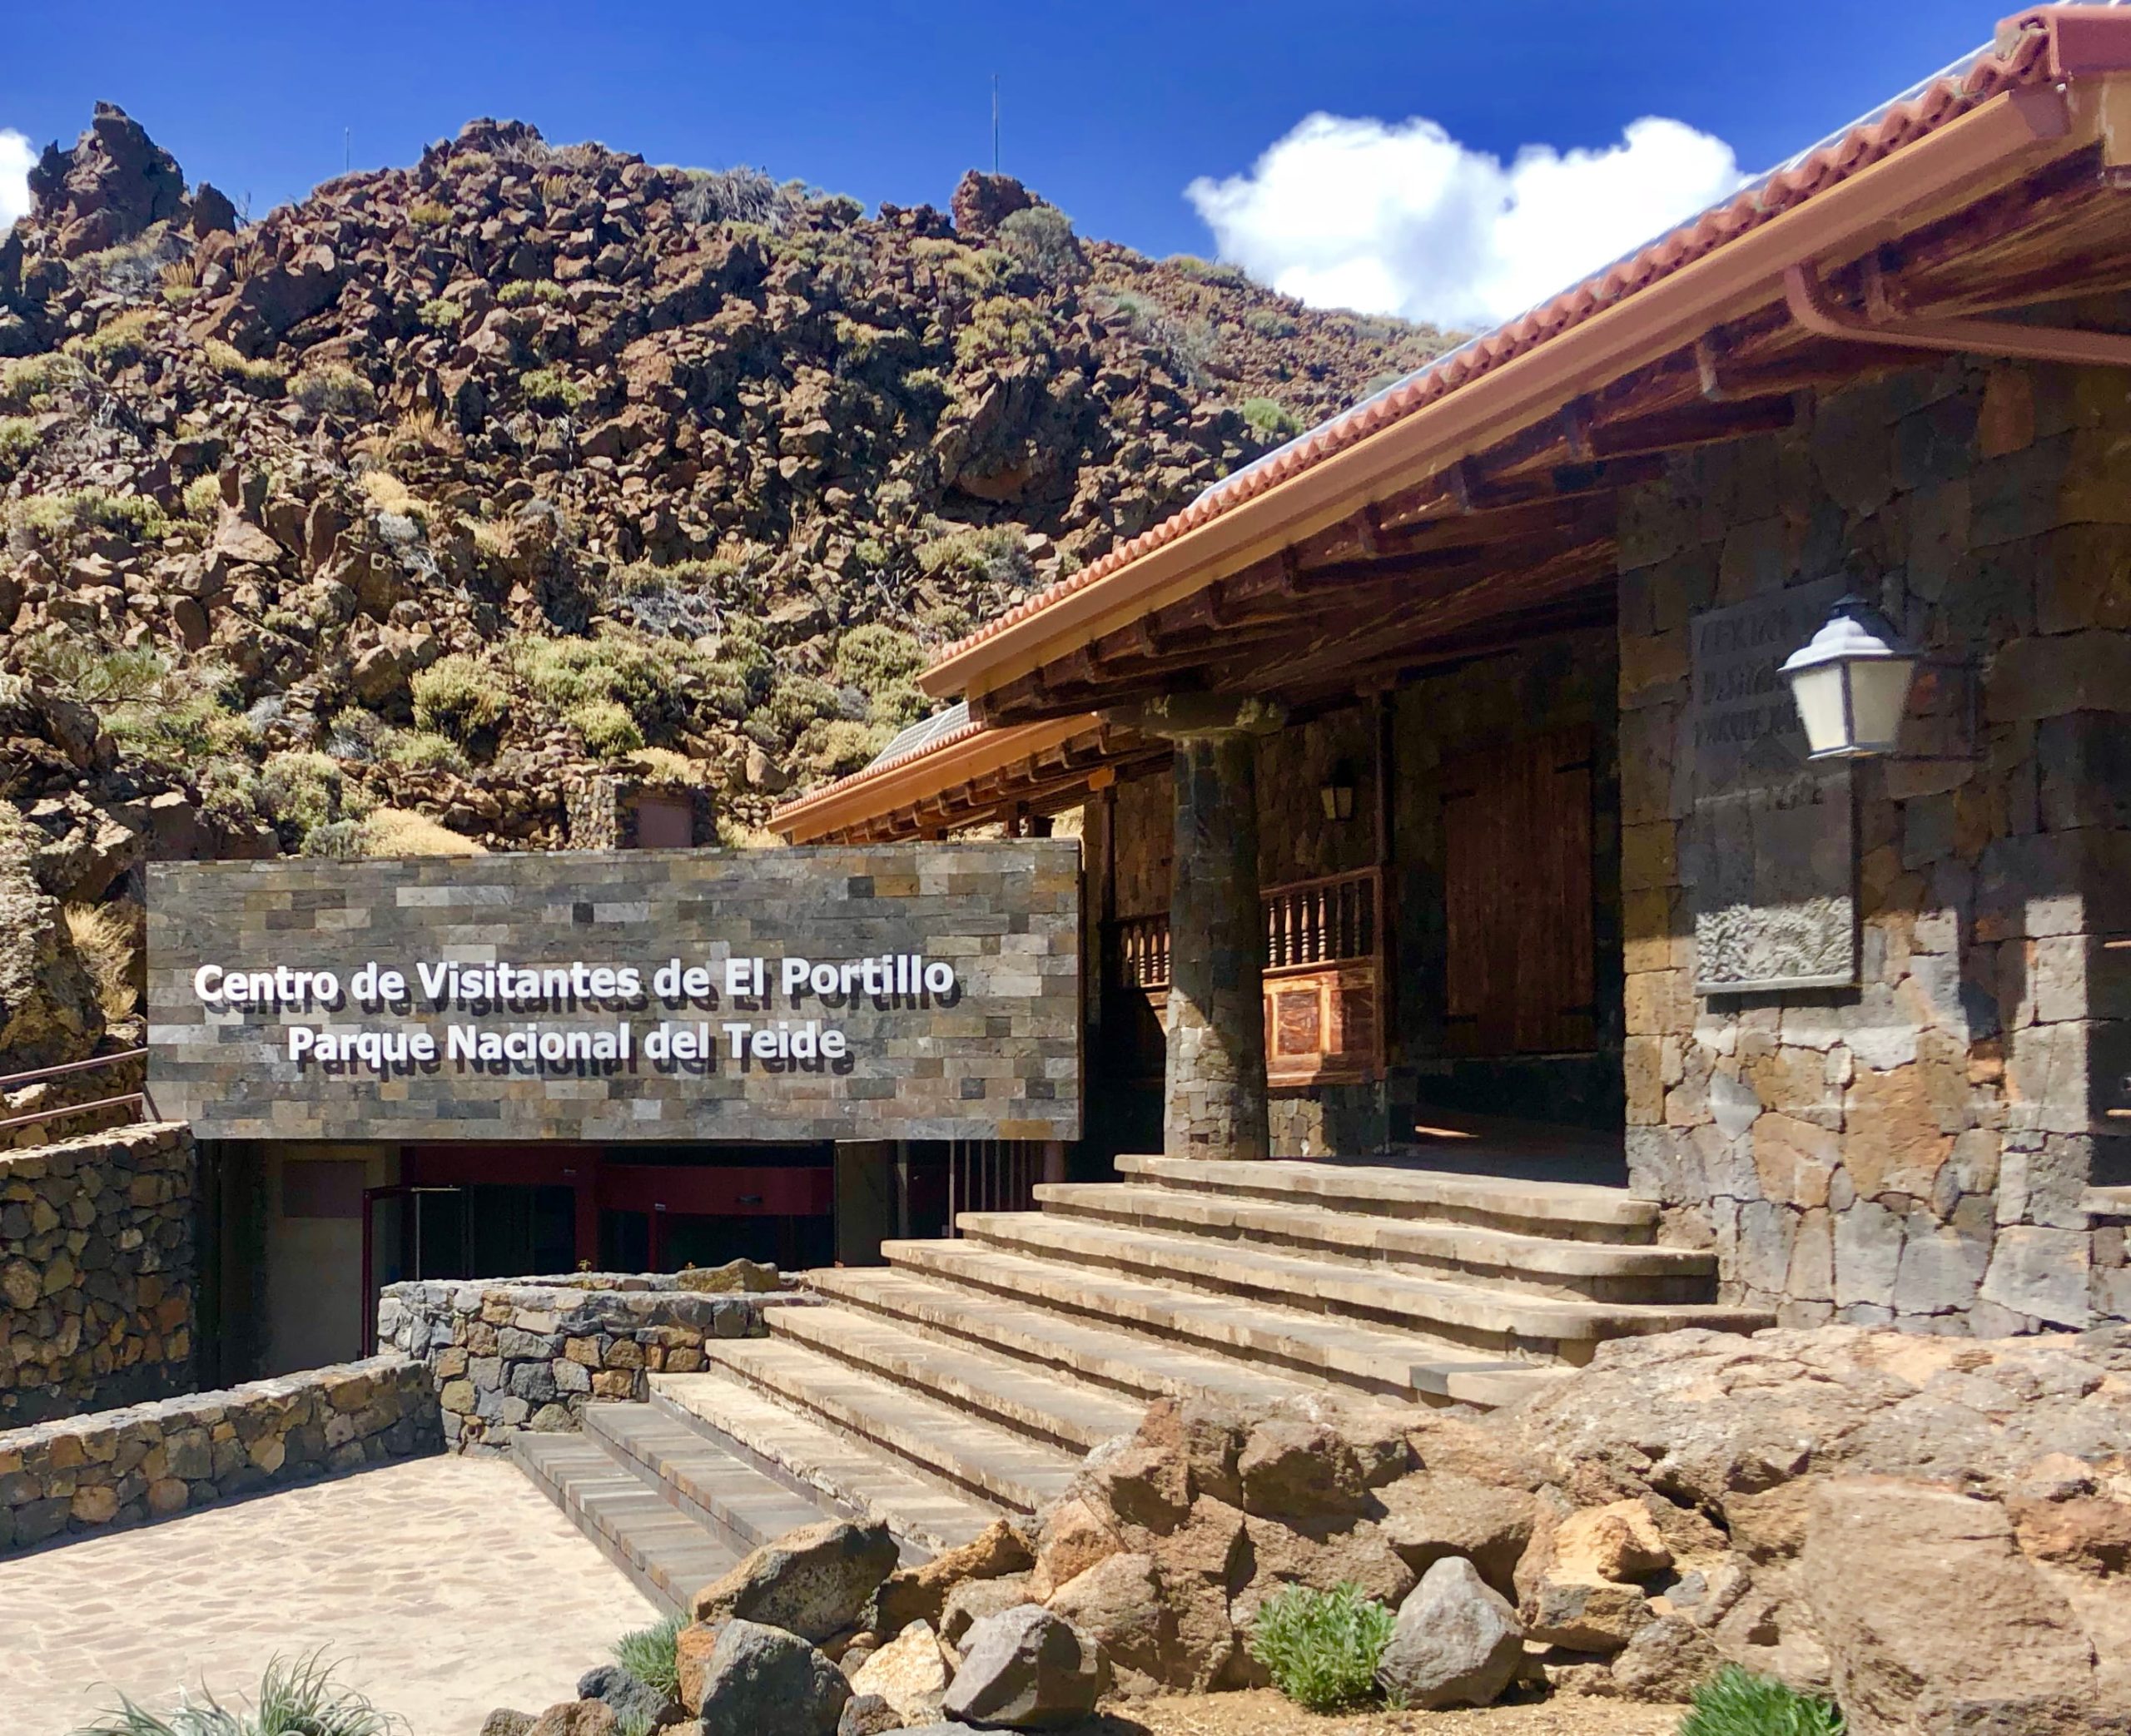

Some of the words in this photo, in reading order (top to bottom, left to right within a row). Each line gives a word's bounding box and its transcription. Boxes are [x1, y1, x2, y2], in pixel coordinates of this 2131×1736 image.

[193, 964, 340, 1002] Centro
[350, 960, 405, 1000] de
[416, 961, 643, 999] Visitantes
[653, 957, 711, 998] de
[724, 956, 765, 996] El
[782, 954, 955, 995] Portillo
[288, 1025, 435, 1069] Parque
[446, 1022, 630, 1061] Nacional
[643, 1021, 710, 1059] del
[721, 1019, 847, 1059] Teide
